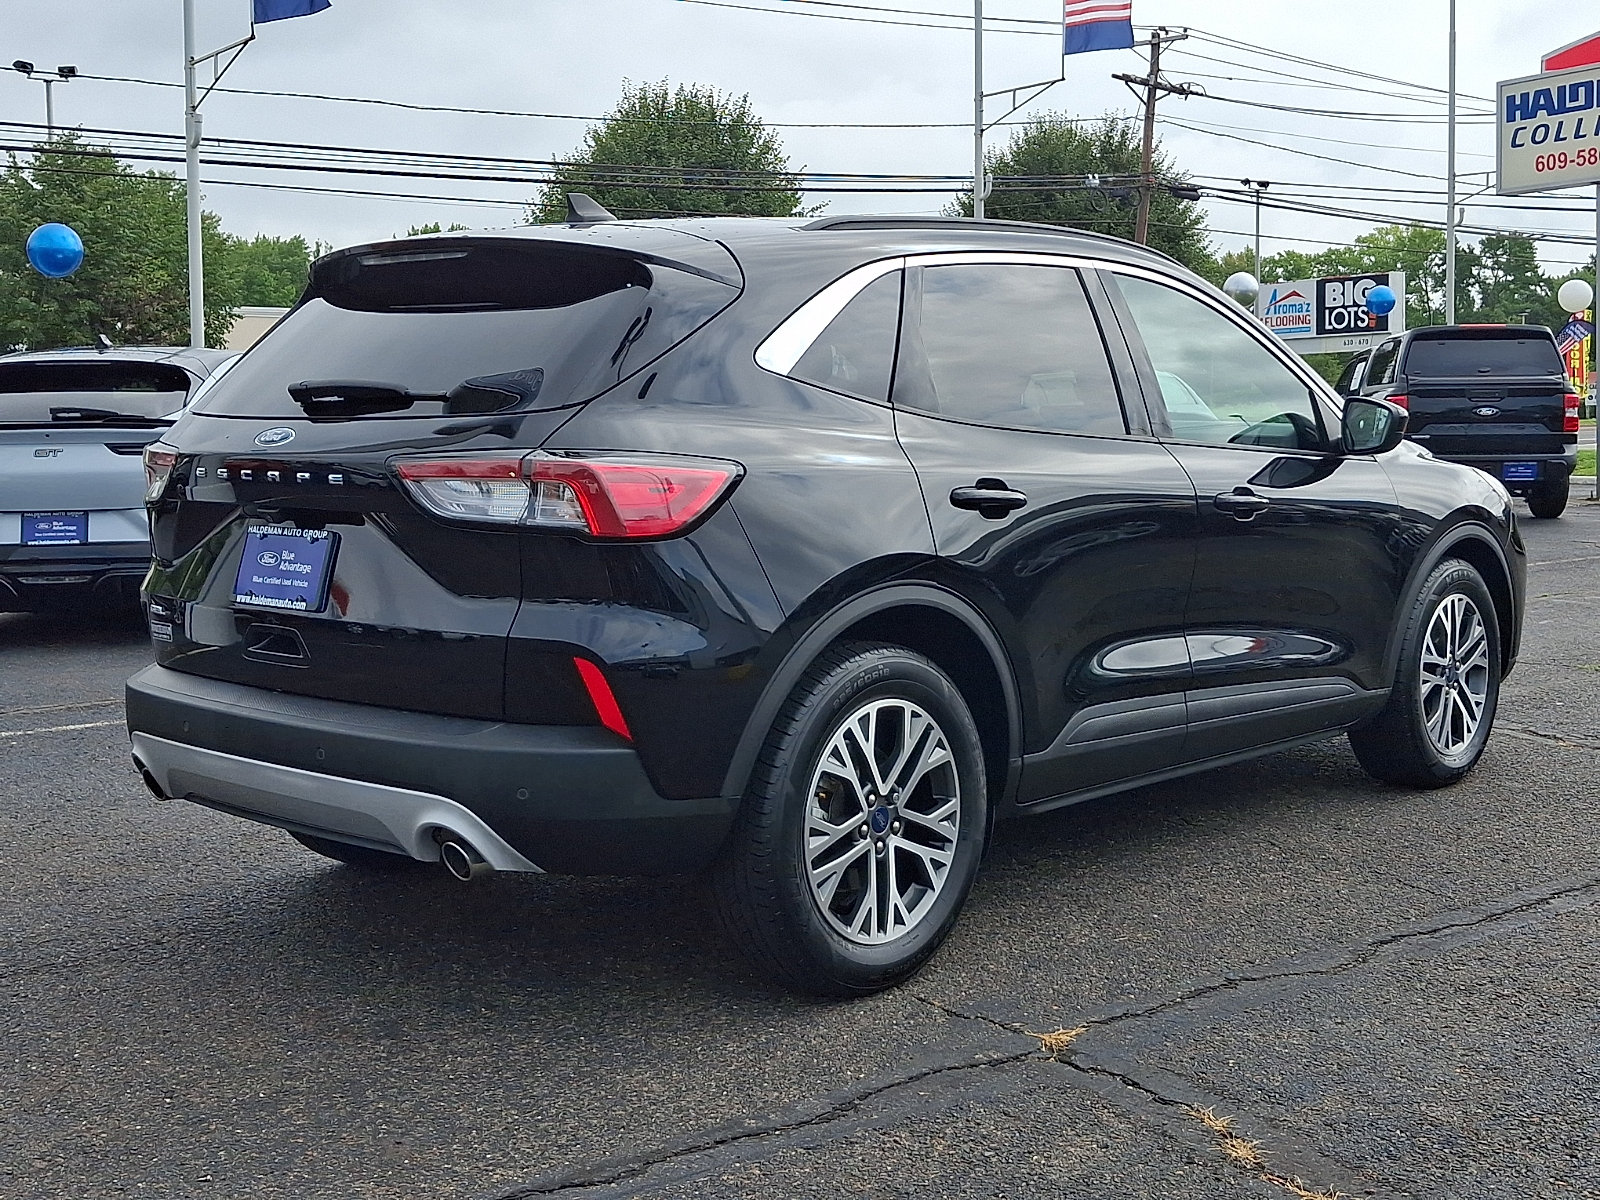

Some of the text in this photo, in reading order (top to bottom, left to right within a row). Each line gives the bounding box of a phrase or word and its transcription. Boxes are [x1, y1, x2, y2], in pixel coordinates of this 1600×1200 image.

[1535, 147, 1600, 172] 609-58
[1325, 279, 1376, 307] BIG
[34, 448, 63, 458] GT
[196, 467, 344, 485] ESCAPE
[248, 525, 328, 539] HALDEMAN AUTO GROUP
[281, 550, 295, 560] Blue
[279, 561, 312, 574] Advantage
[236, 594, 306, 610] www.haldemanauto.com
